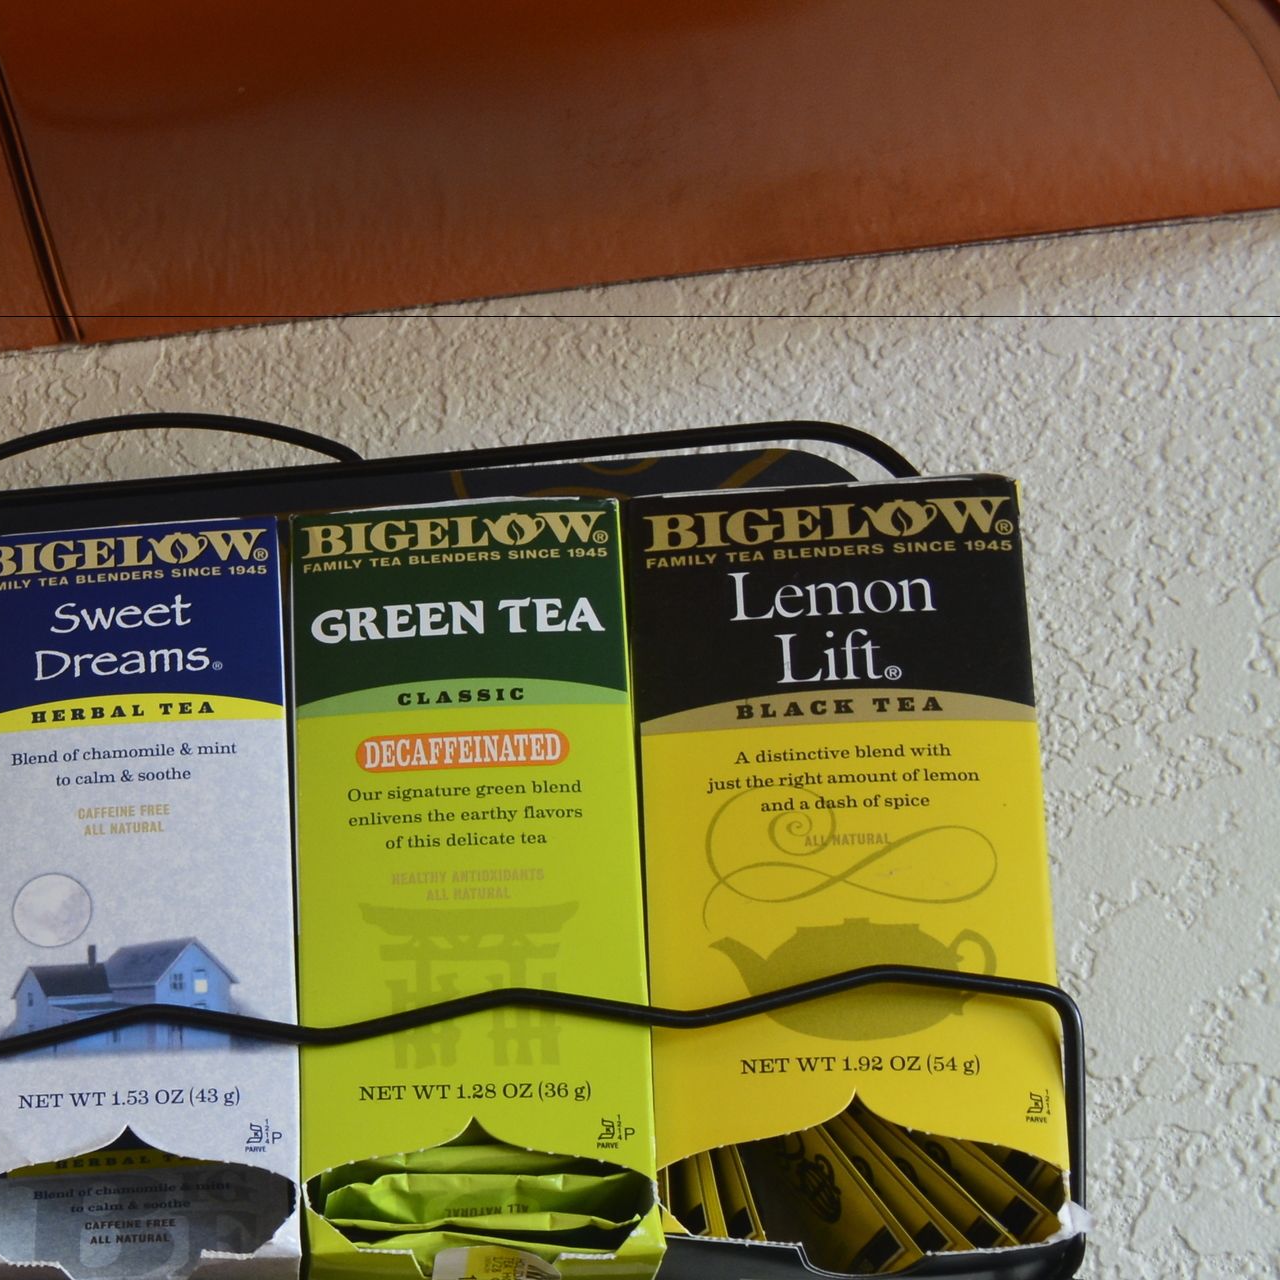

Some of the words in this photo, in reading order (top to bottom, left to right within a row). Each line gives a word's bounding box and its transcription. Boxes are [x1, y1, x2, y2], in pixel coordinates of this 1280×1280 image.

[302, 511, 608, 559] BIGELOW
[643, 496, 1014, 552] BIGELOW
[304, 559, 362, 573] FAMILY
[369, 557, 401, 567] TEA
[409, 551, 500, 565] BLENDERS
[508, 549, 560, 559] SINCE
[567, 548, 607, 557] 1945
[646, 554, 716, 569] FAMILY
[727, 551, 764, 562] TEA
[773, 544, 884, 560] BLENDERS
[893, 541, 956, 553] SINCE
[964, 540, 1012, 551] 1945
[728, 572, 936, 621] Lemon
[50, 594, 191, 633] Sweet
[311, 600, 484, 643] GREEN
[498, 597, 605, 633] TEA
[35, 647, 210, 680] Dreams
[775, 629, 882, 683] Lift
[398, 688, 523, 705] CLASSIC
[736, 699, 853, 719] BLACK
[872, 697, 943, 712] TEA
[32, 705, 144, 723] HERBAL
[159, 702, 214, 715] TEA
[11, 750, 58, 766] Blend
[63, 749, 79, 762] of
[83, 744, 174, 760] chamomile
[180, 743, 192, 755] &
[198, 742, 236, 754] mint
[364, 729, 561, 769] DECAFFEINATED
[735, 752, 750, 764] A
[756, 747, 849, 763] distinctive
[855, 744, 904, 758] blend
[910, 744, 951, 756] with
[57, 776, 70, 786] to
[76, 771, 115, 785] calm
[121, 770, 133, 782] &
[138, 768, 191, 781] soothe
[707, 778, 741, 794] just
[746, 775, 774, 788] the
[779, 772, 822, 789] right
[828, 773, 897, 784] amount
[902, 769, 920, 781] of
[924, 768, 979, 781] lemon
[348, 789, 382, 802] Our
[388, 786, 469, 801] signature
[476, 785, 526, 798] green
[532, 780, 581, 793] blend
[761, 798, 794, 812] and
[800, 801, 810, 810] a
[815, 795, 857, 809] dash
[863, 794, 879, 807] of
[884, 794, 929, 809] spice
[349, 812, 422, 826] enlivens
[428, 809, 455, 822] the
[461, 807, 517, 822] earthy
[524, 806, 582, 818] flavors
[386, 836, 403, 849] of
[408, 835, 440, 848] this
[447, 833, 515, 846] delicate
[521, 832, 547, 844] tea
[741, 1058, 789, 1074] NET
[796, 1057, 836, 1072] WT
[843, 1056, 883, 1071] 1.92
[890, 1056, 921, 1071] OZ
